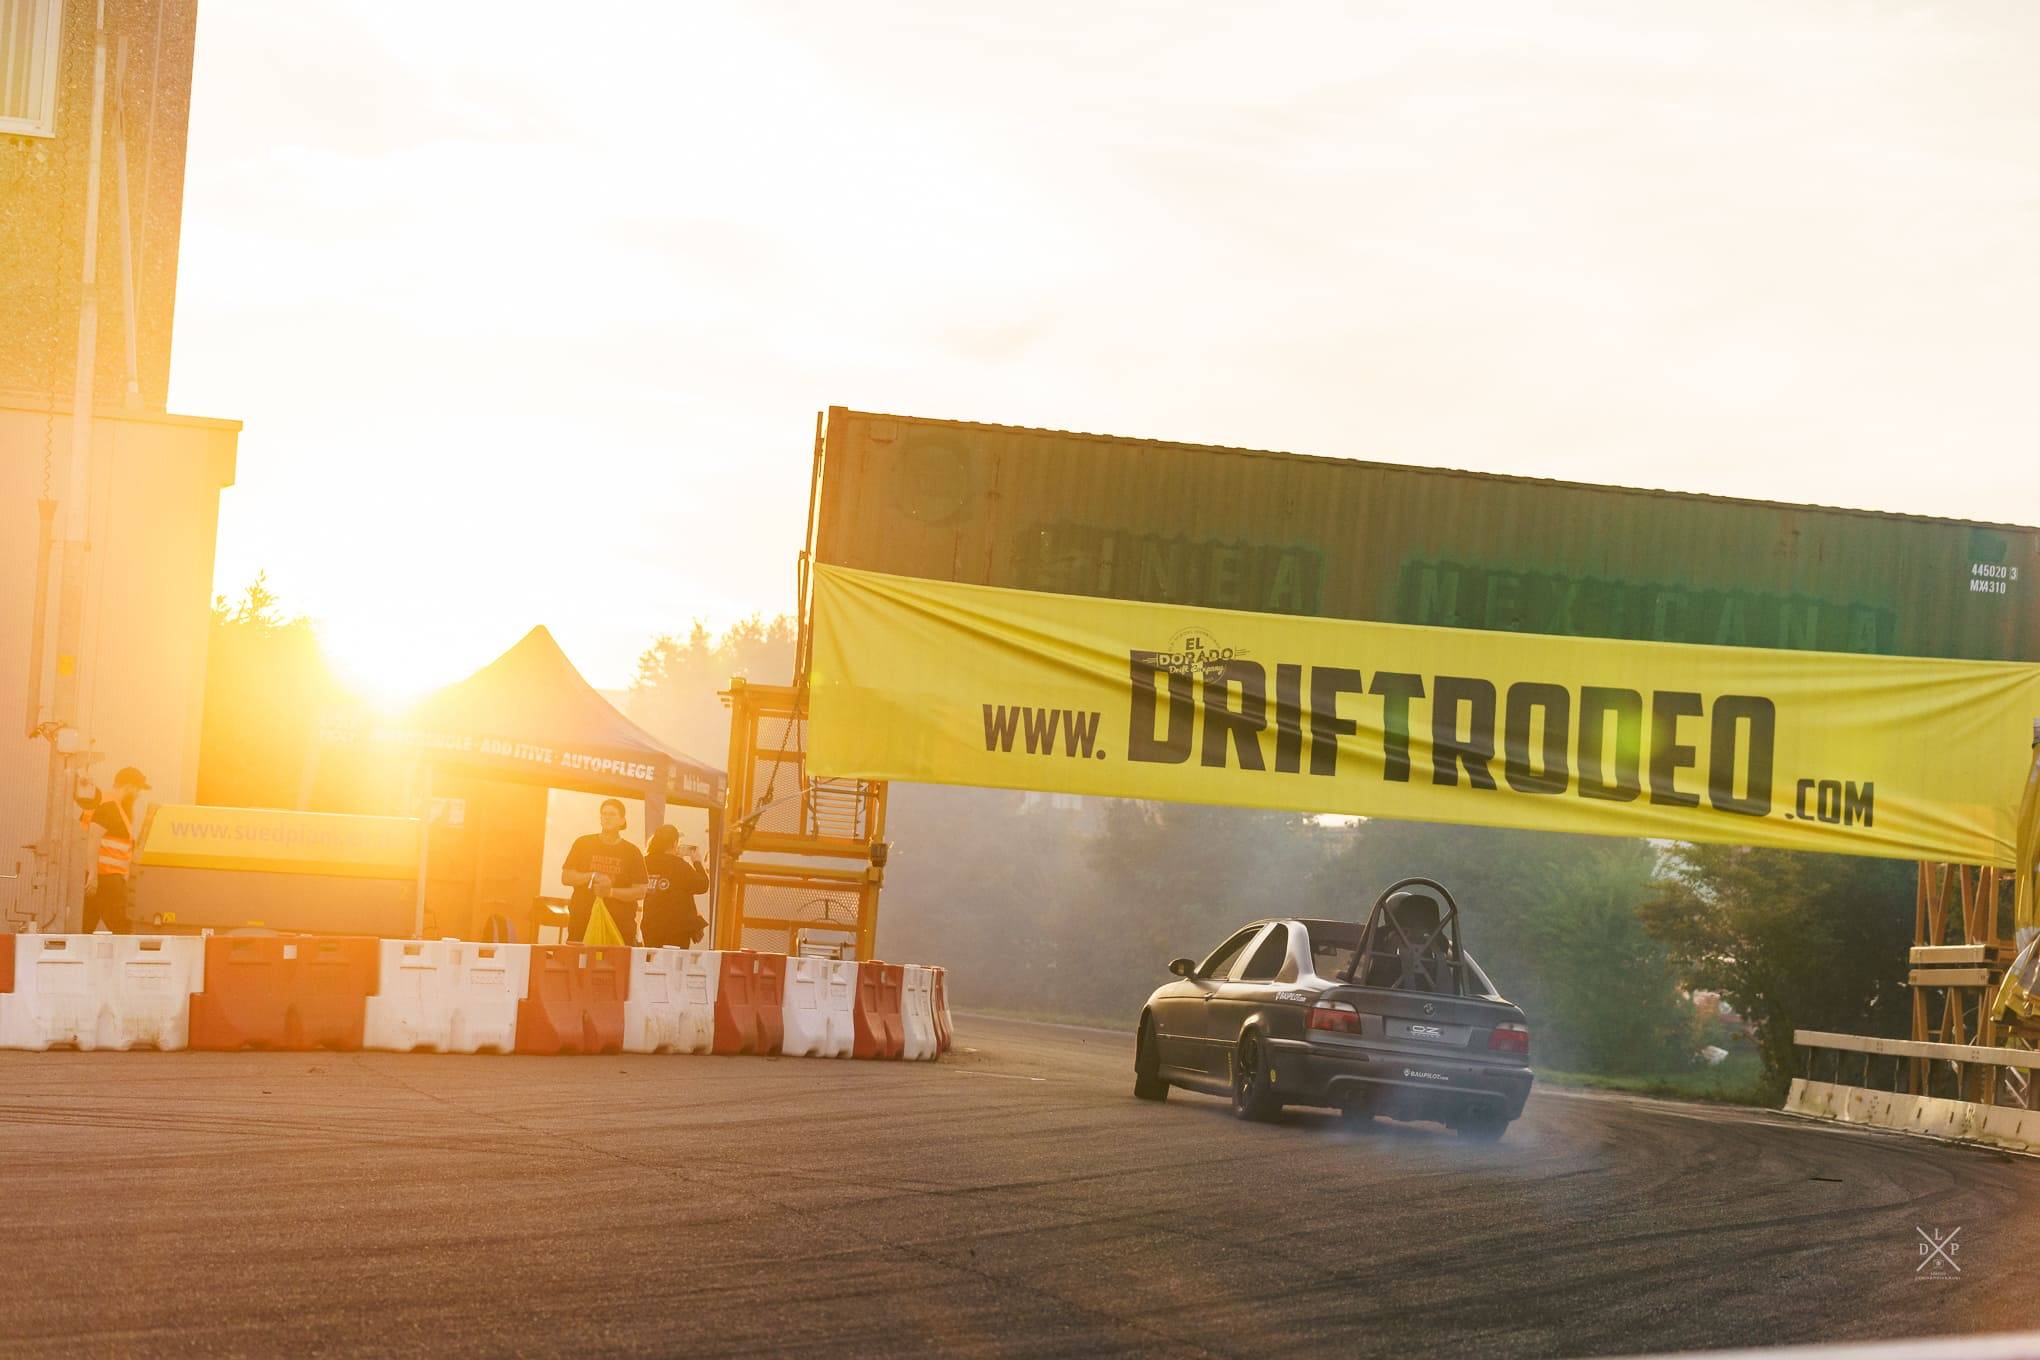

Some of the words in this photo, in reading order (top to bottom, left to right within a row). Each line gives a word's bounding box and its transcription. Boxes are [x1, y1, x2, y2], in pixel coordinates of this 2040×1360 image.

[1971, 563, 2007, 578] 445020
[1185, 637, 1204, 651] EL
[1158, 648, 1234, 666] DORADO
[1168, 665, 1190, 677] Drift
[560, 752, 655, 781] AUTOPFLEGE
